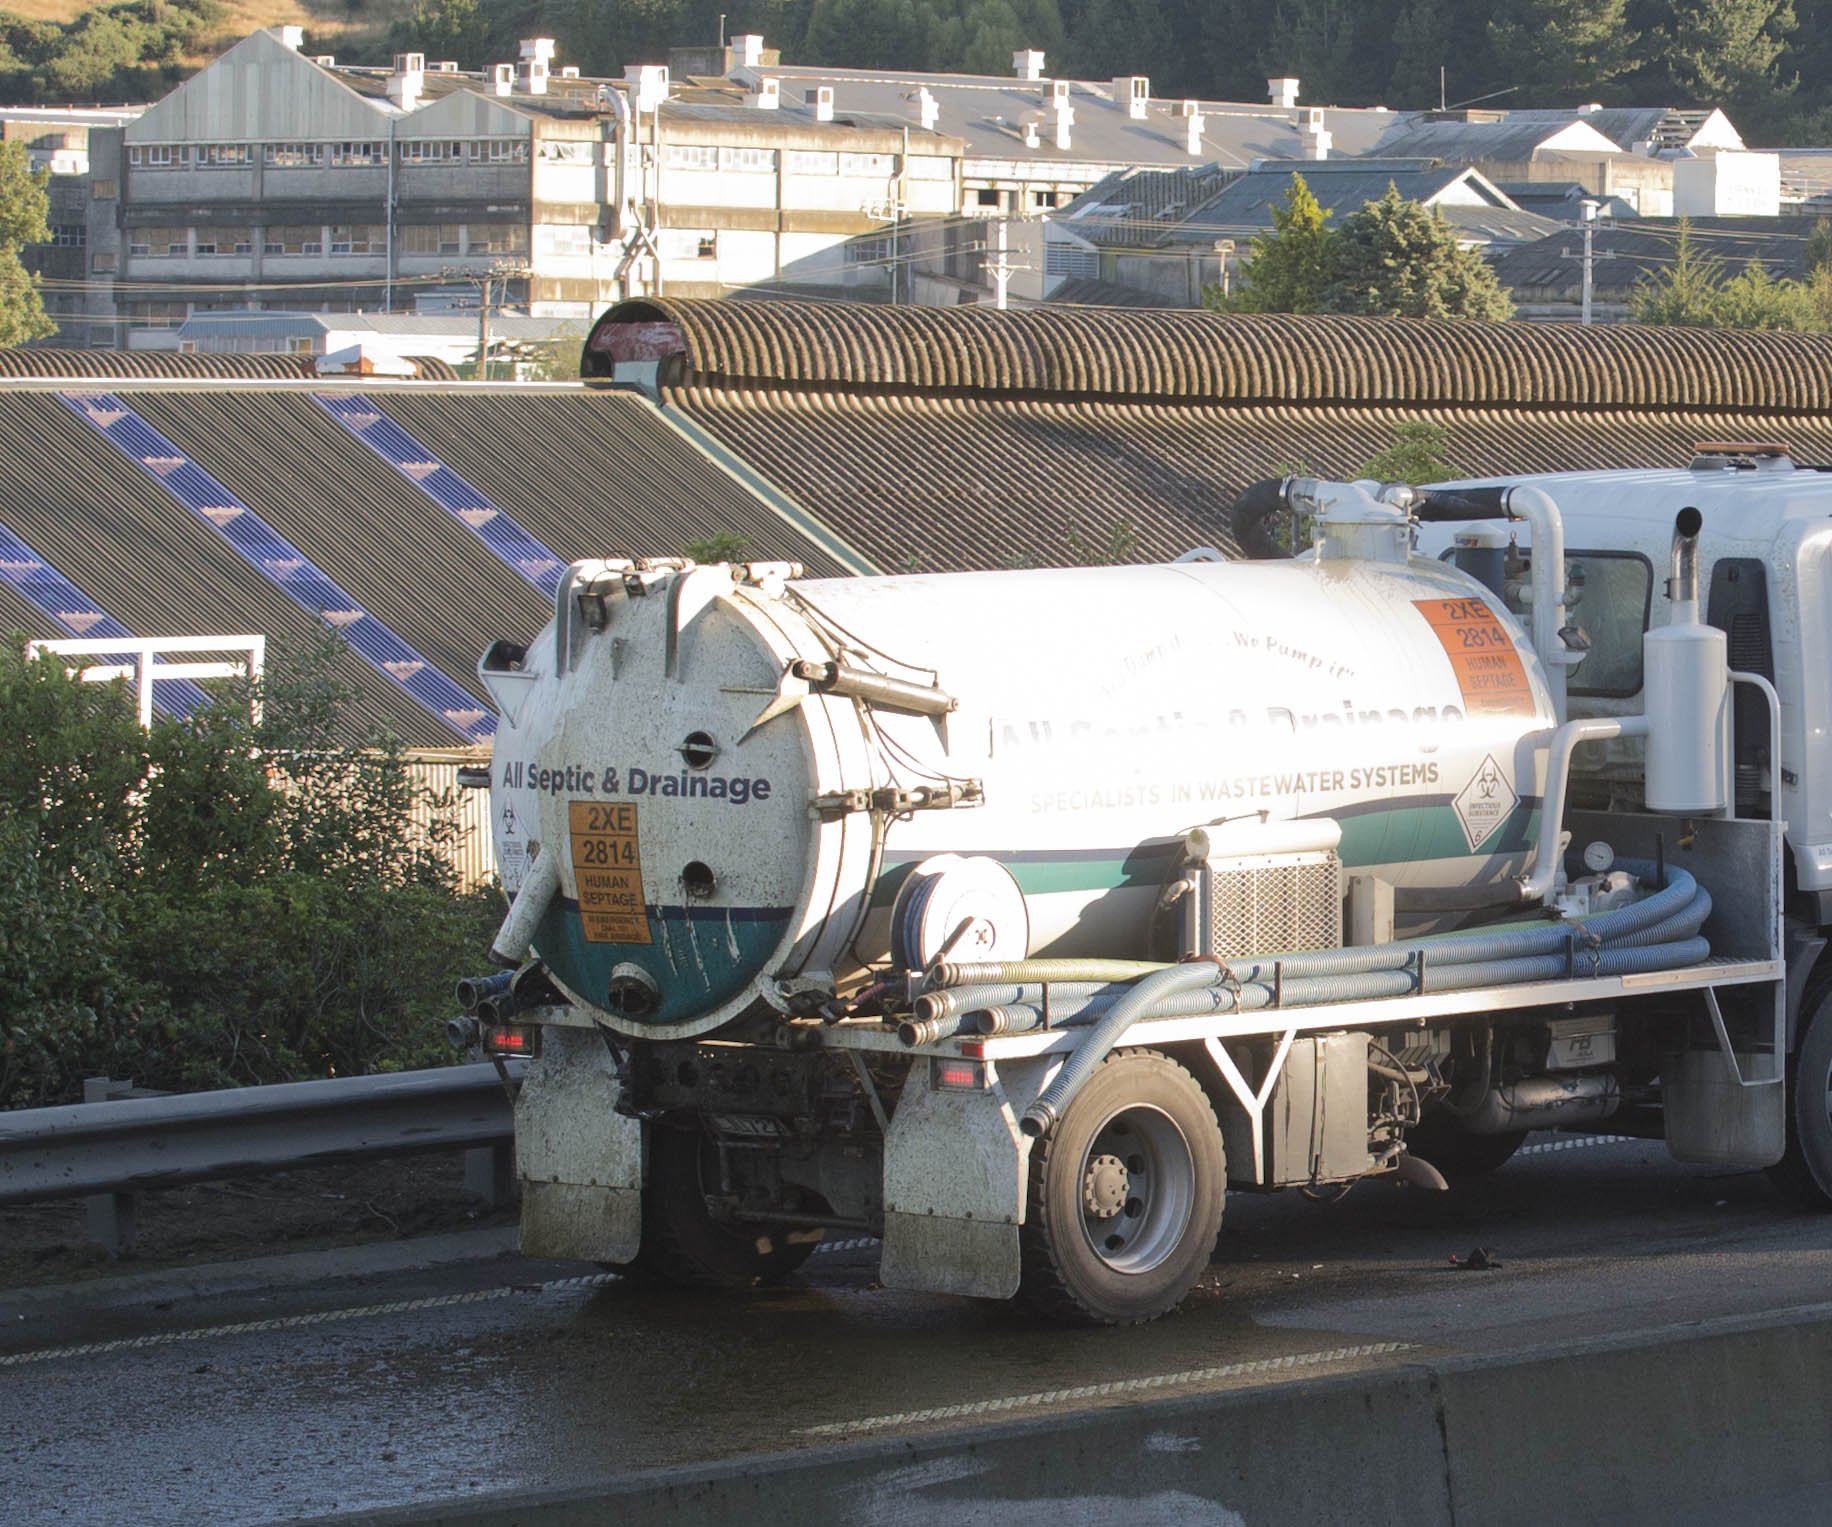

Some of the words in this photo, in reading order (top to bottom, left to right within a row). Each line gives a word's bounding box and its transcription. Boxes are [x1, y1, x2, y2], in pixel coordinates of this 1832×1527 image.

[1443, 600, 1490, 620] 2XE
[1456, 627, 1505, 648] 2814
[1465, 655, 1507, 671] HUMAN
[1469, 672, 1518, 689] SEPTAGE
[503, 761, 523, 789] All
[527, 763, 595, 796] Septic
[601, 767, 620, 794] &
[627, 768, 772, 804] Drainage
[1031, 784, 1161, 815] SPECIALISTS
[1171, 782, 1193, 803] IN
[1199, 769, 1345, 801] WASTEWATER
[1349, 761, 1439, 789] SYSTEMS
[588, 807, 633, 831] 2XE
[583, 840, 636, 864] 2814
[585, 875, 629, 888] HUMAN
[583, 892, 639, 906] SEPTAGE
